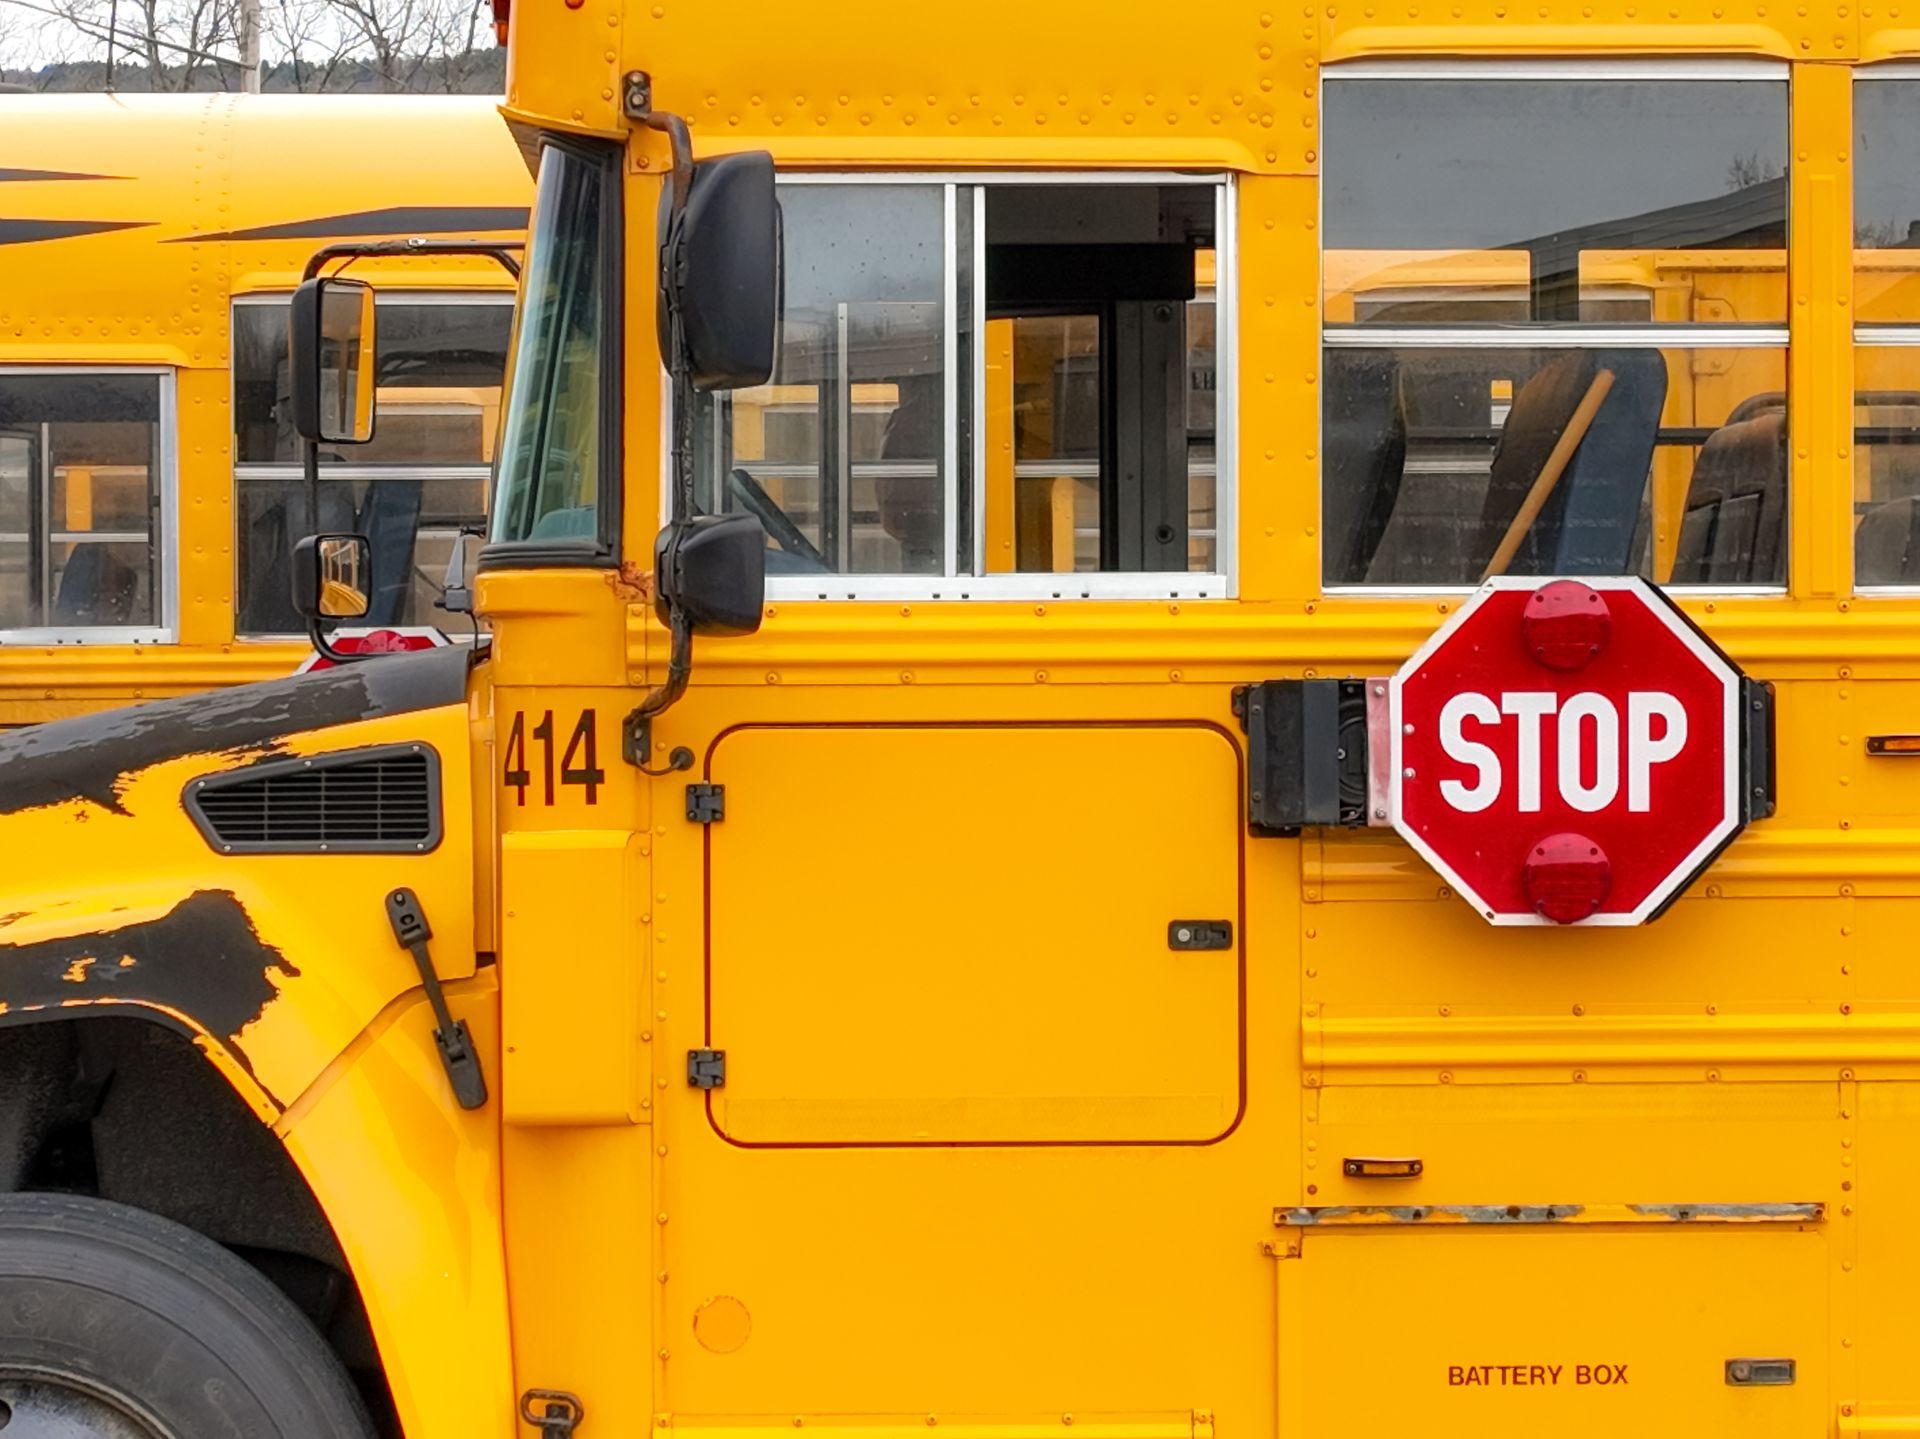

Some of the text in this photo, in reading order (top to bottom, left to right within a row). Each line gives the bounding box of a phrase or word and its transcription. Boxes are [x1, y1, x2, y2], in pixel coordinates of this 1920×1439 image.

[504, 709, 605, 805] 414
[1440, 691, 1688, 813] STOP
[1448, 1364, 1629, 1386] BATTERY BOX
